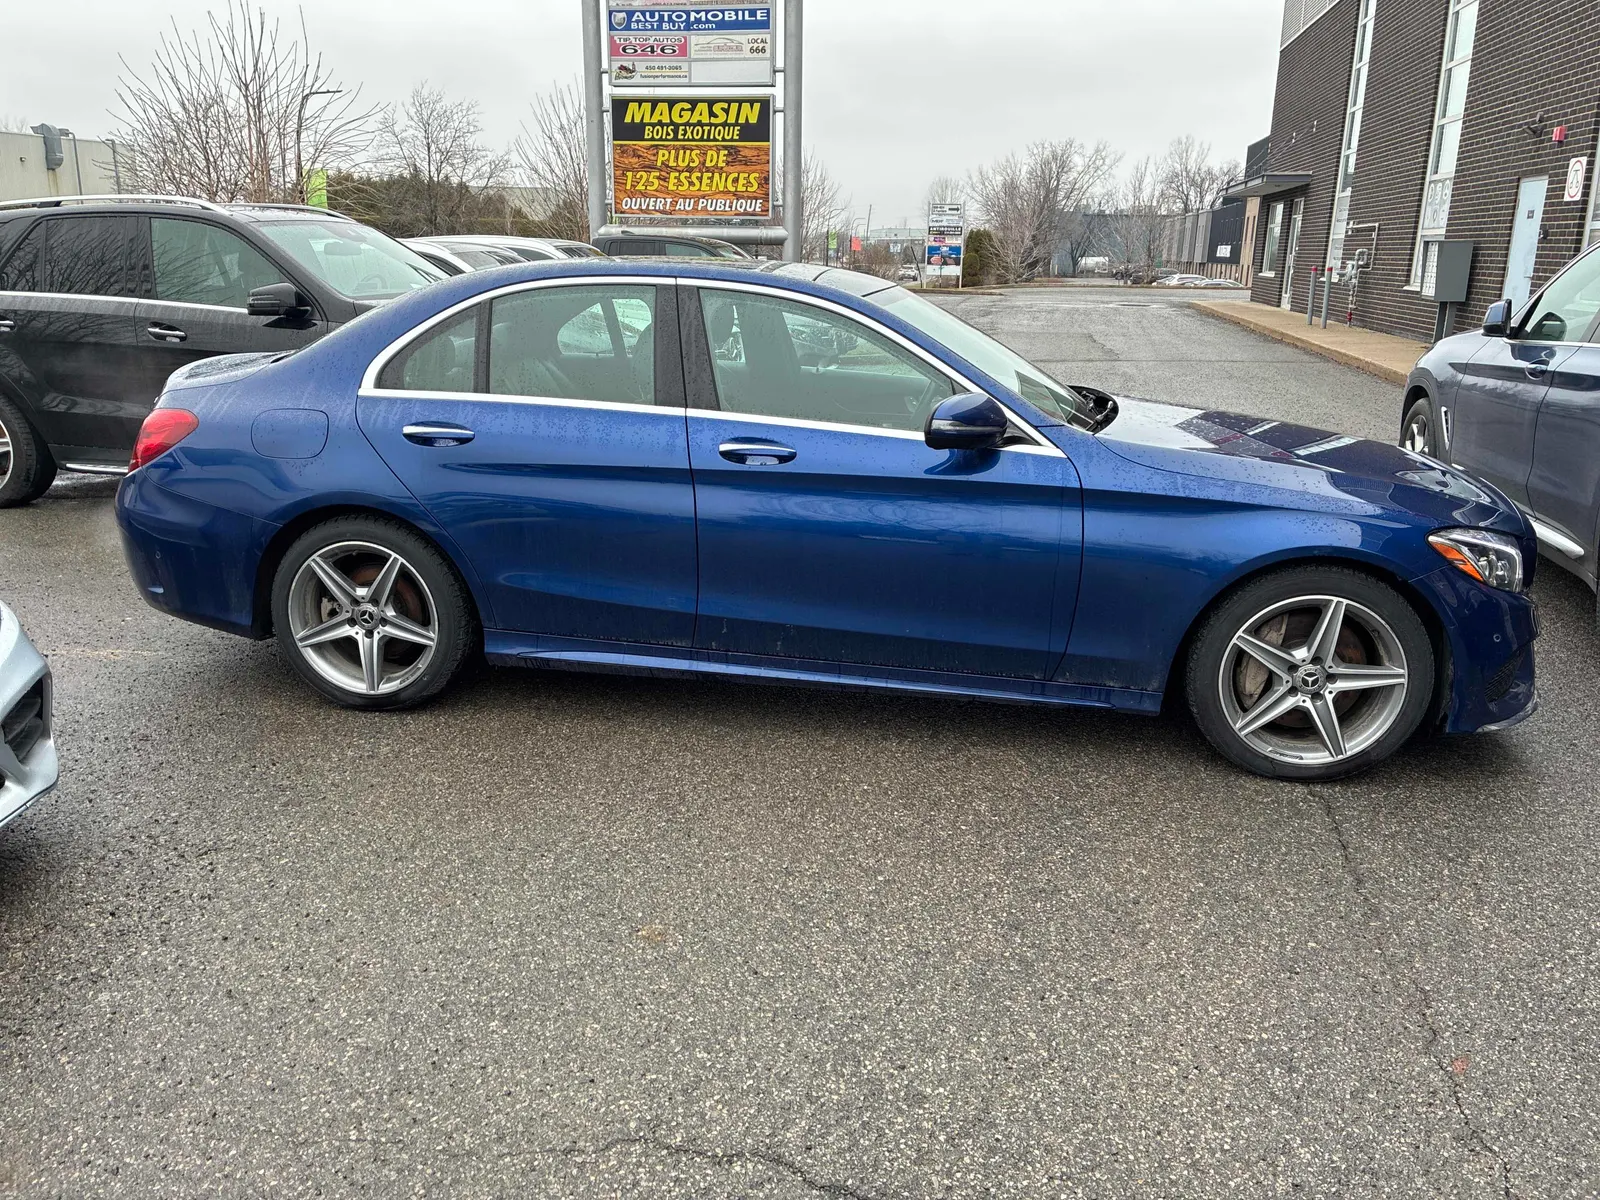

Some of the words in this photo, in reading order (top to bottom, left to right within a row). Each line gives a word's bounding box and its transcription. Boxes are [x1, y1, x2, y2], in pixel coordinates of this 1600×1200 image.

[631, 10, 768, 22] AUTOMOBILE
[631, 22, 660, 30] BEST
[662, 22, 686, 30] BUY
[621, 45, 678, 55] 646
[749, 46, 766, 54] 666
[624, 102, 761, 124] MAGASIN
[644, 125, 675, 139] BOIS
[677, 126, 740, 141] EXOTIQUE
[656, 150, 700, 167] PLUS
[705, 150, 728, 167] DE
[625, 172, 660, 190] 125
[668, 172, 760, 192] ESSENCES
[622, 198, 672, 210] OUVERT
[676, 199, 694, 210] AU
[698, 199, 763, 212] PUBLIQUE
